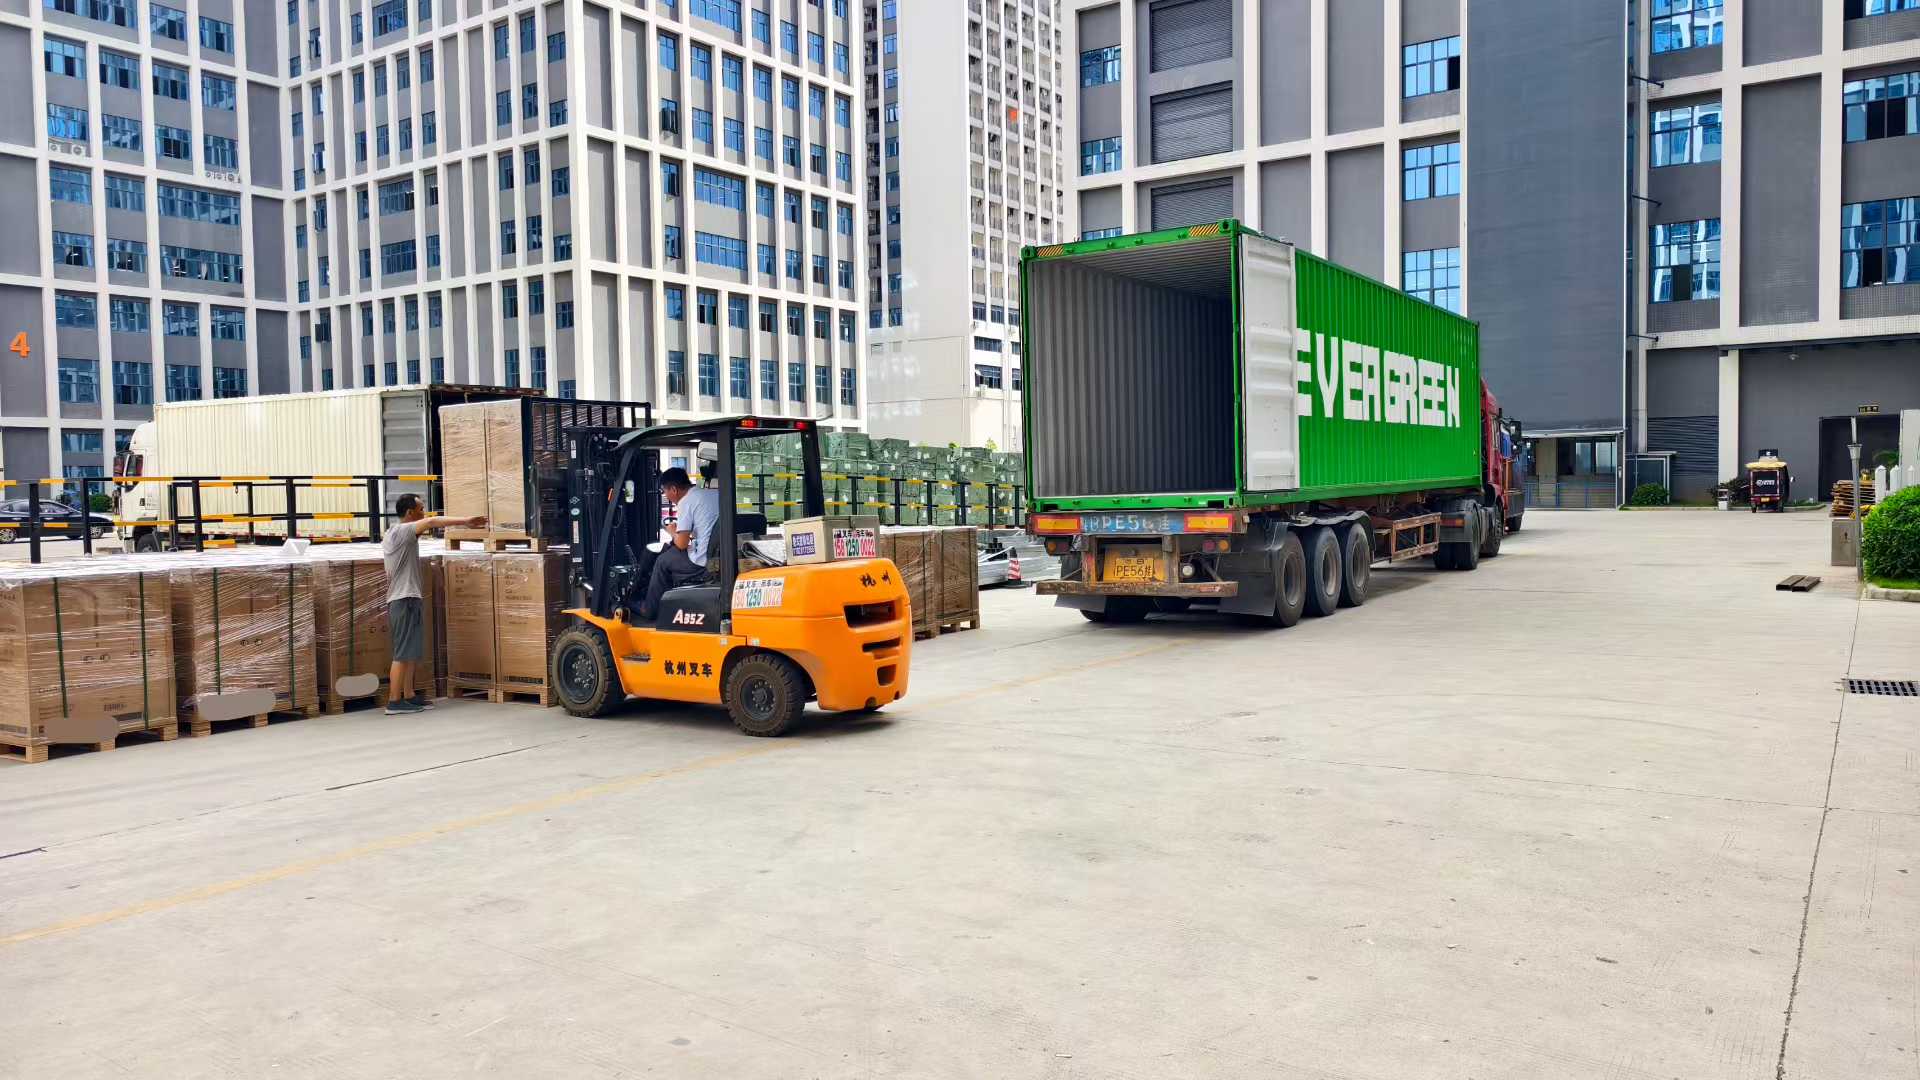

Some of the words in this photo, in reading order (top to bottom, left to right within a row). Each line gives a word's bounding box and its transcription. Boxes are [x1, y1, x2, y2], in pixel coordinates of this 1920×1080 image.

[9, 331, 30, 358] 4
[1296, 327, 1460, 428] EVERGREEN
[846, 537, 860, 557] 1250
